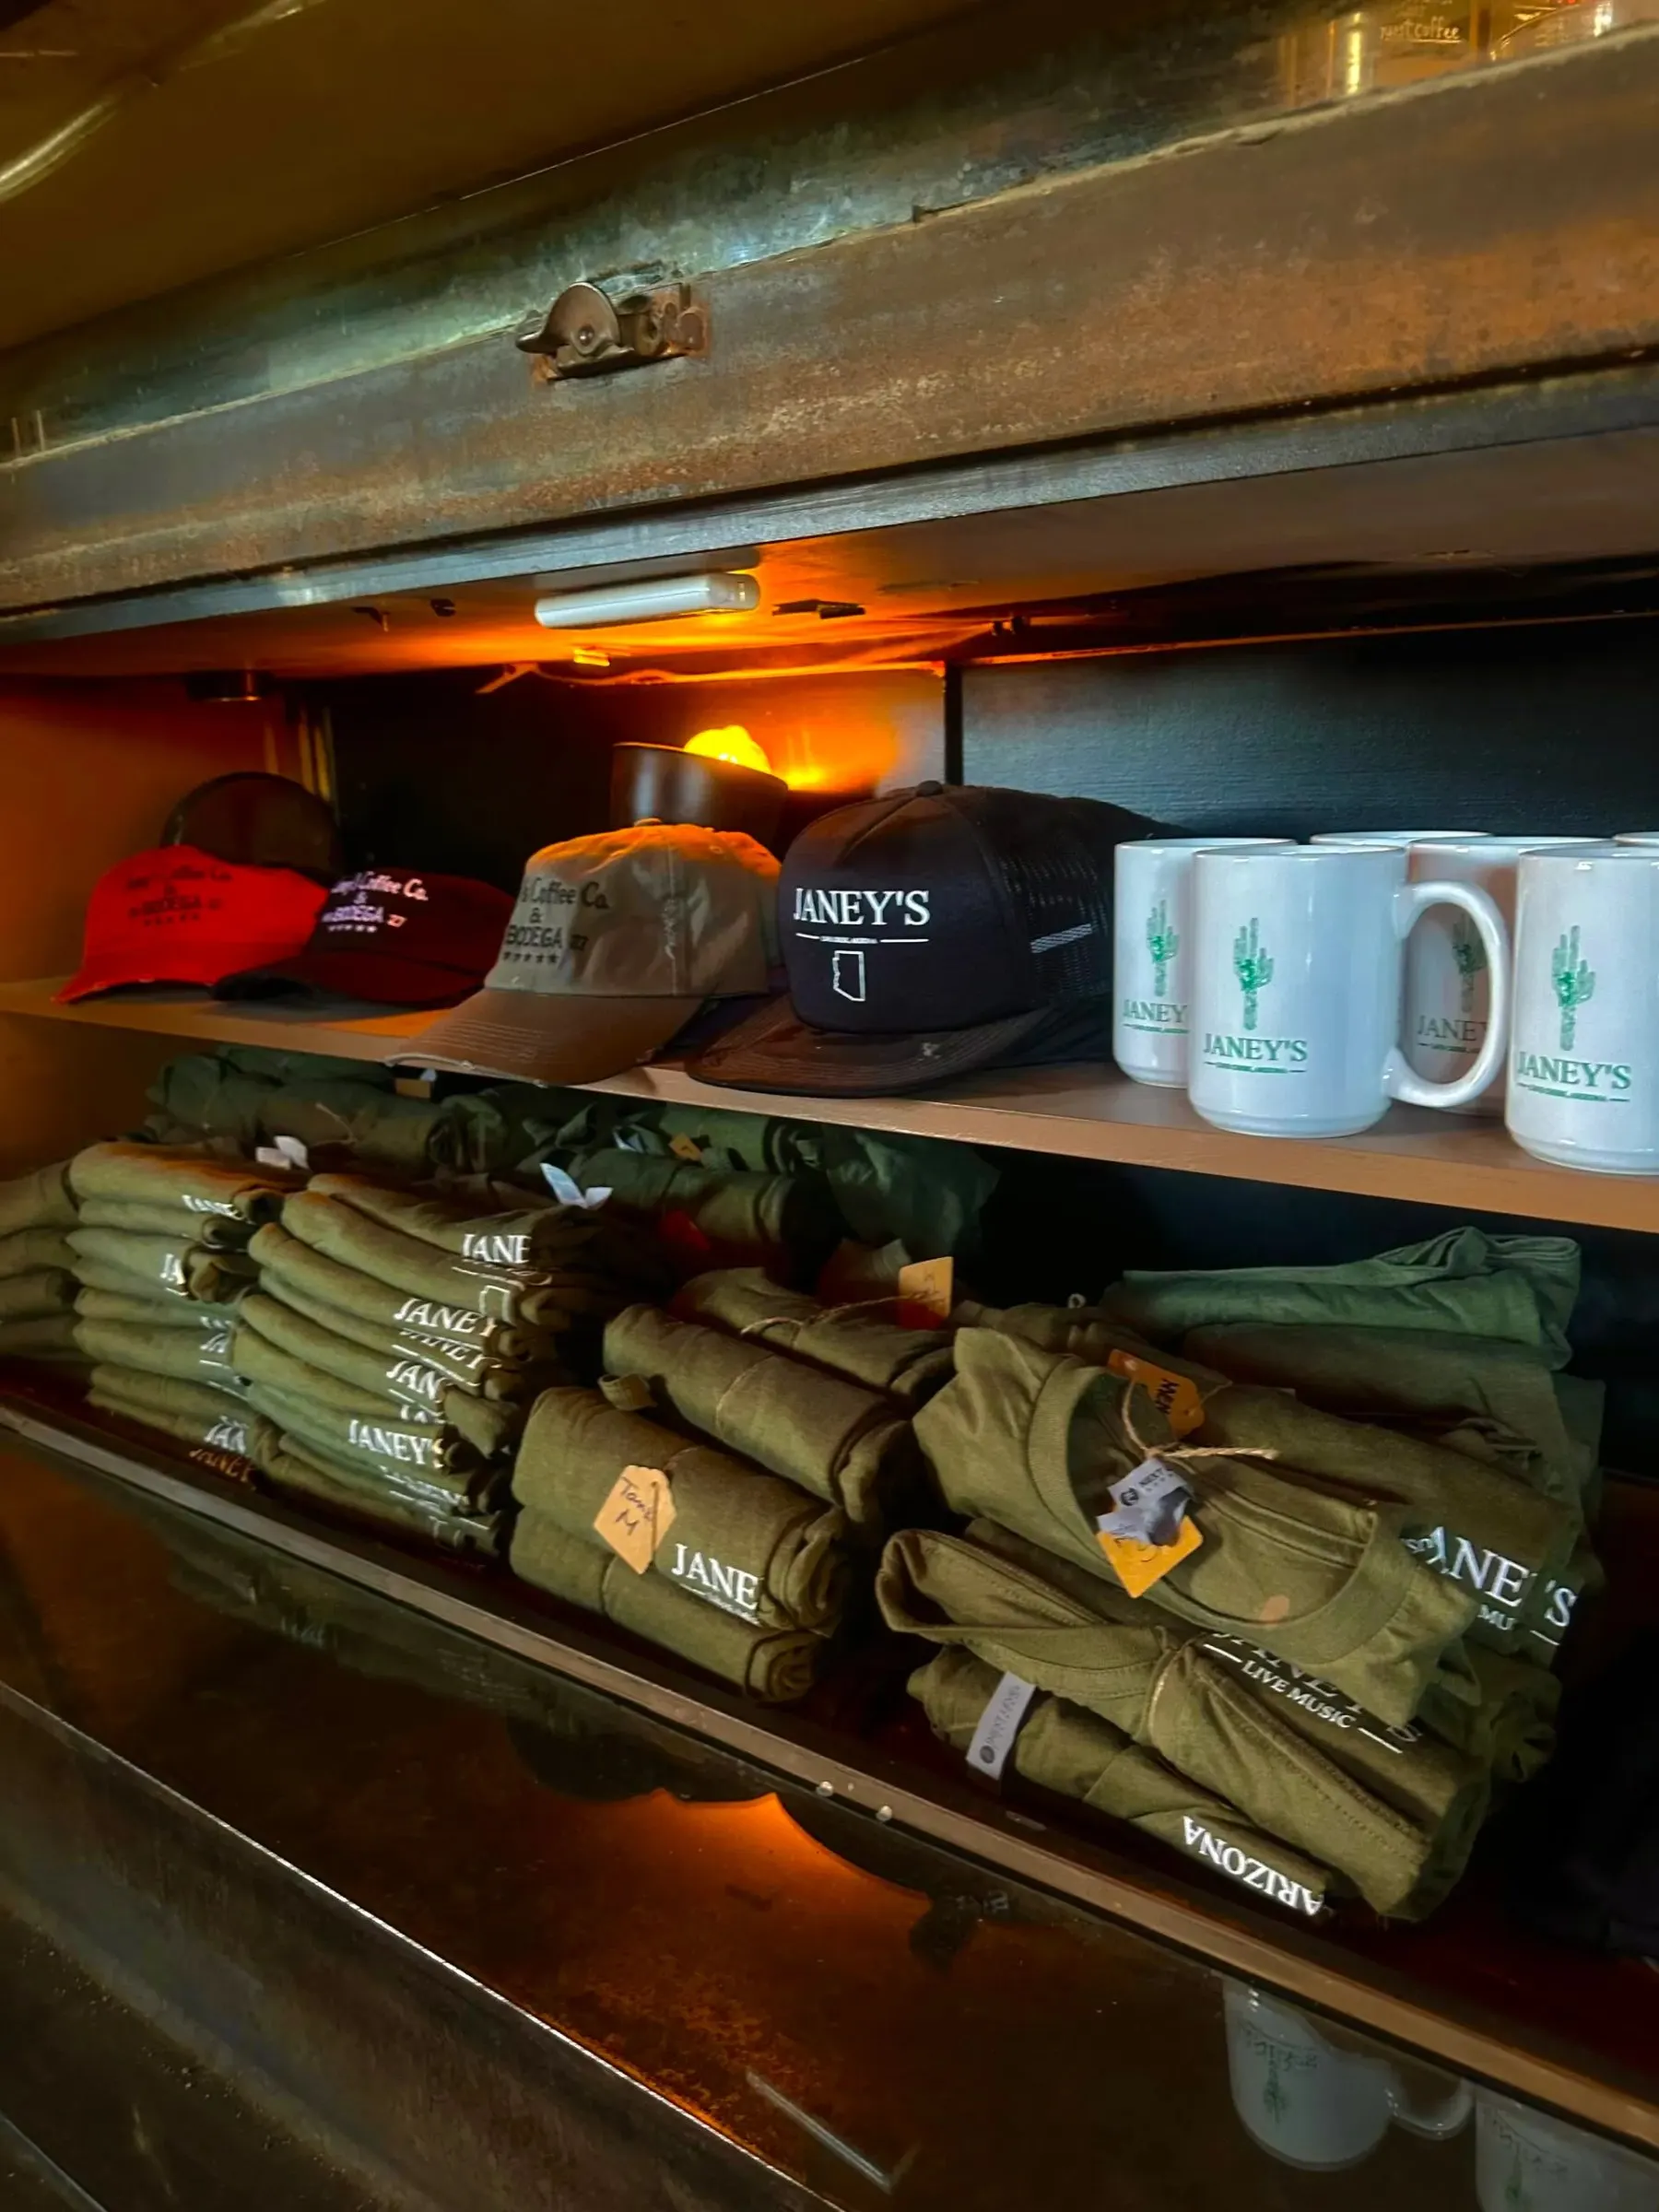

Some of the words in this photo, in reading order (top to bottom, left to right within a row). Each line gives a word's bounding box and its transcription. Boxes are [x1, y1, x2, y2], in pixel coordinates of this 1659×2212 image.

[531, 877, 577, 904] Coffee
[794, 888, 931, 925] JANEY'S
[528, 907, 542, 924] &
[505, 924, 563, 949] BODEGA
[1203, 1033, 1309, 1063] JANEY'S
[1516, 1051, 1632, 1090] JANEY'S
[1241, 1660, 1291, 1693] LIVE
[1287, 1688, 1358, 1729] MUSIC
[1182, 1816, 1324, 1916] ARIZONA
